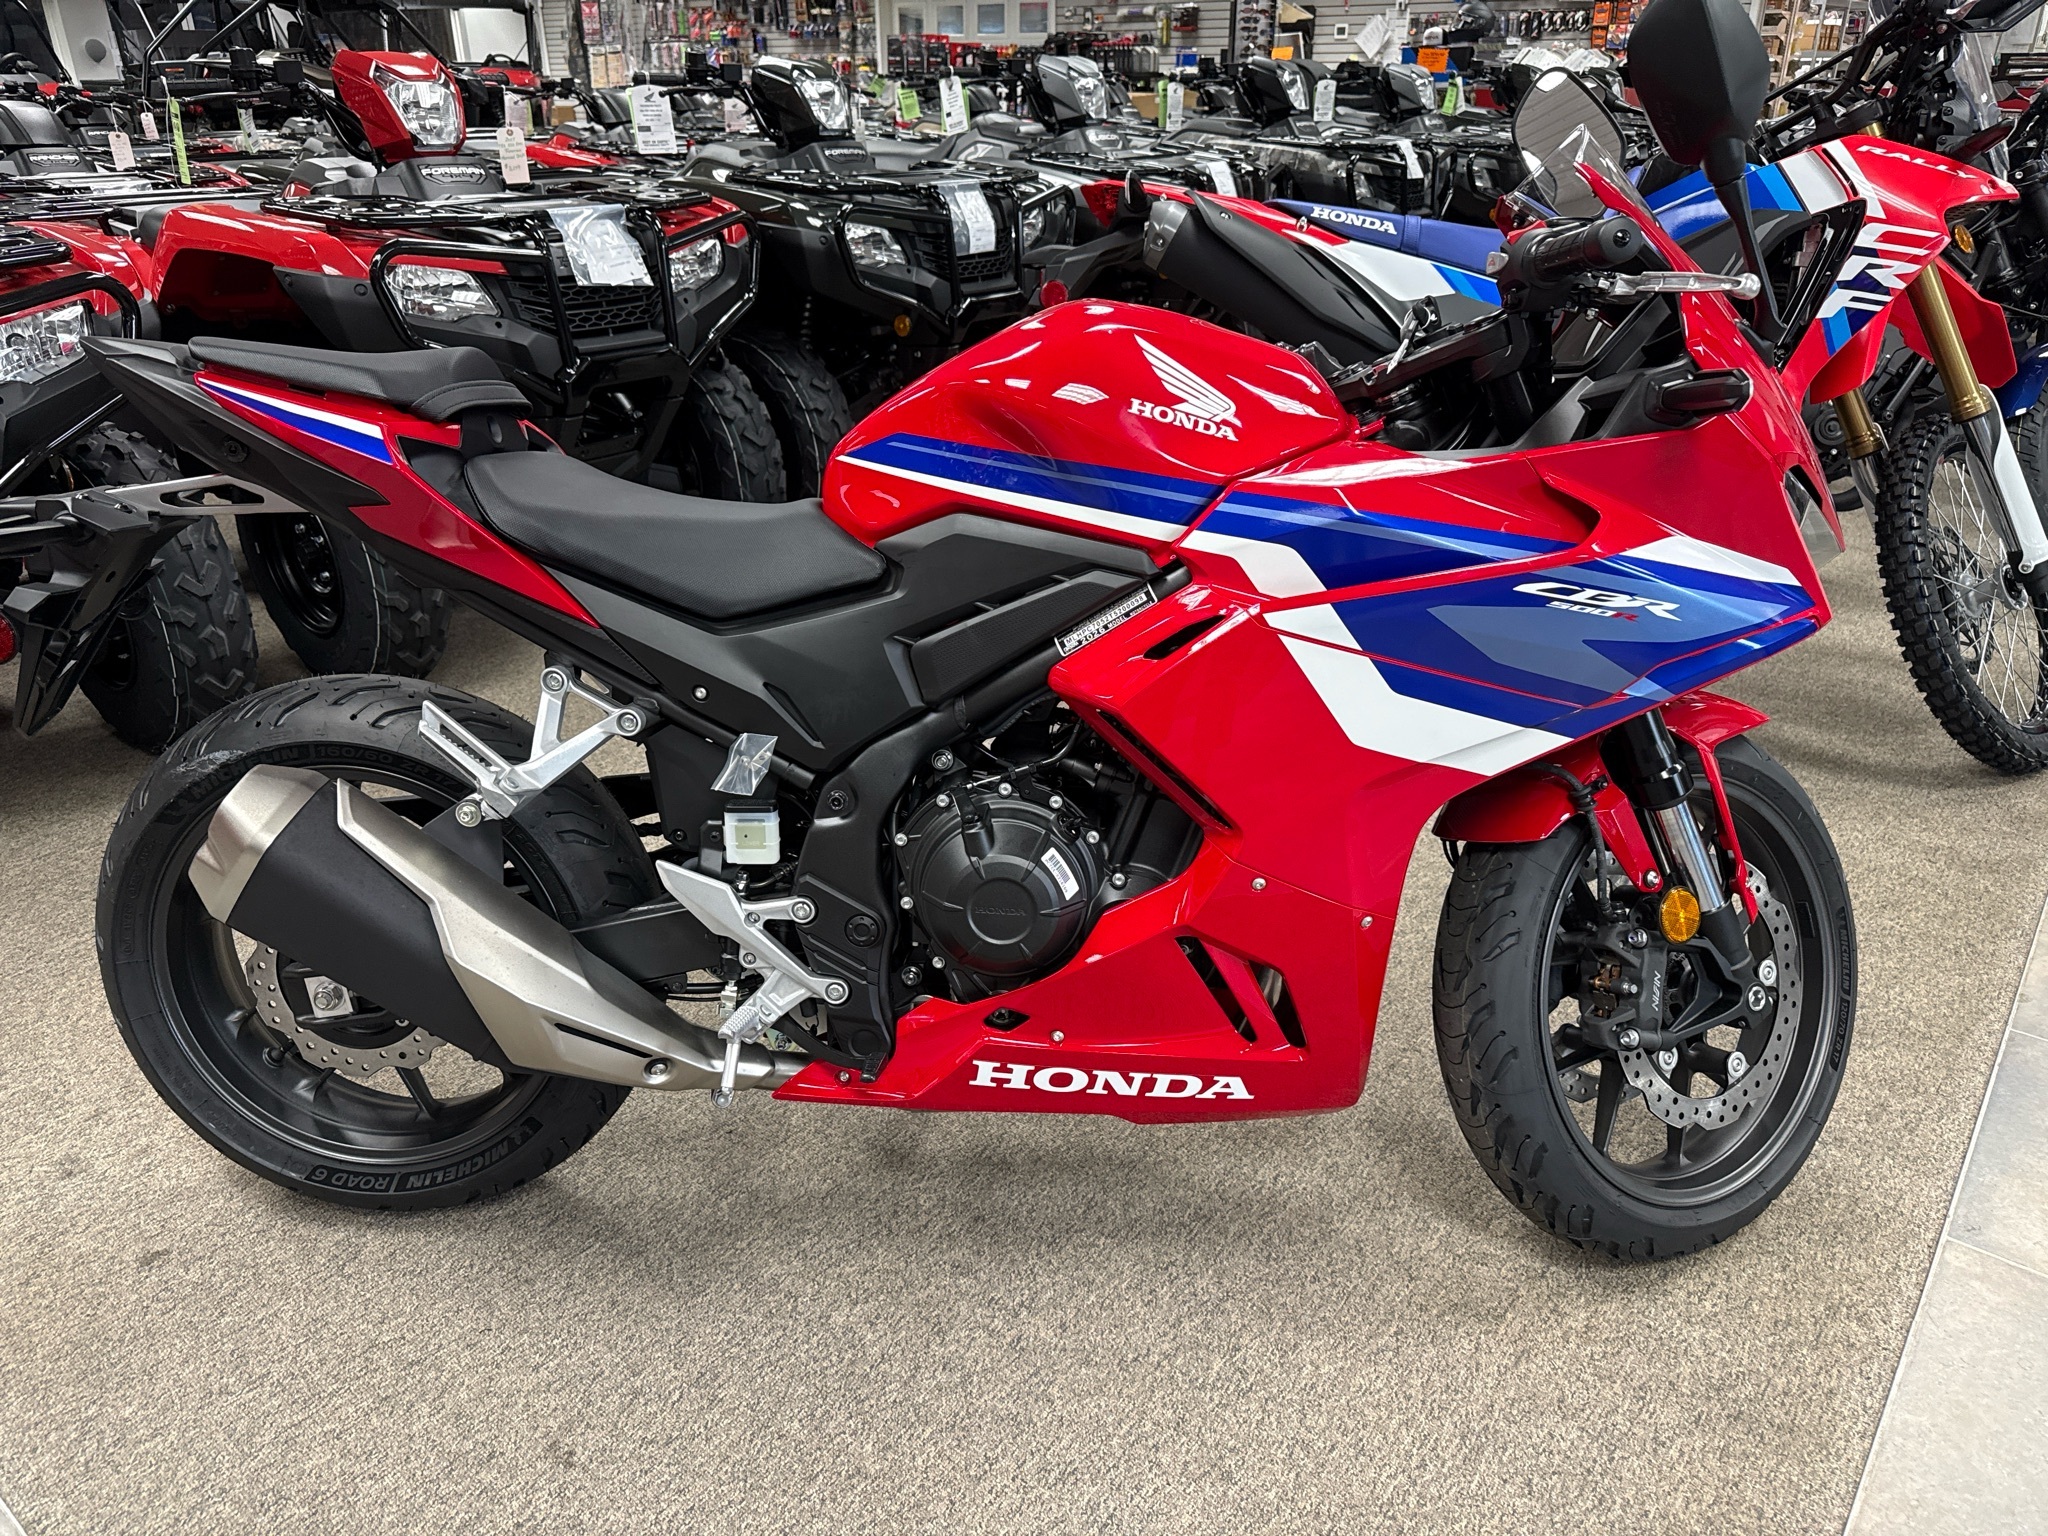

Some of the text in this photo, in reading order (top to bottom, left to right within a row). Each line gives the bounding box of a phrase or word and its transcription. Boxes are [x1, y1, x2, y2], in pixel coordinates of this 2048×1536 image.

[28, 154, 80, 162] RANCHER
[420, 166, 486, 176] FOREMAN
[1856, 145, 1979, 179] RALLY
[1310, 206, 1397, 235] HONDA
[1127, 398, 1239, 442] HONDA
[1512, 581, 1682, 622] CBR
[1545, 600, 1640, 622] 500R
[1080, 626, 1106, 645] 2026
[1107, 614, 1128, 629] MODEL
[975, 906, 1027, 917] HONDA
[1832, 929, 1851, 1063] MICHELIN 120/70 ZR 17
[968, 1059, 1255, 1100] HONDA
[311, 1141, 509, 1190] MICHELIN ROAD 6
